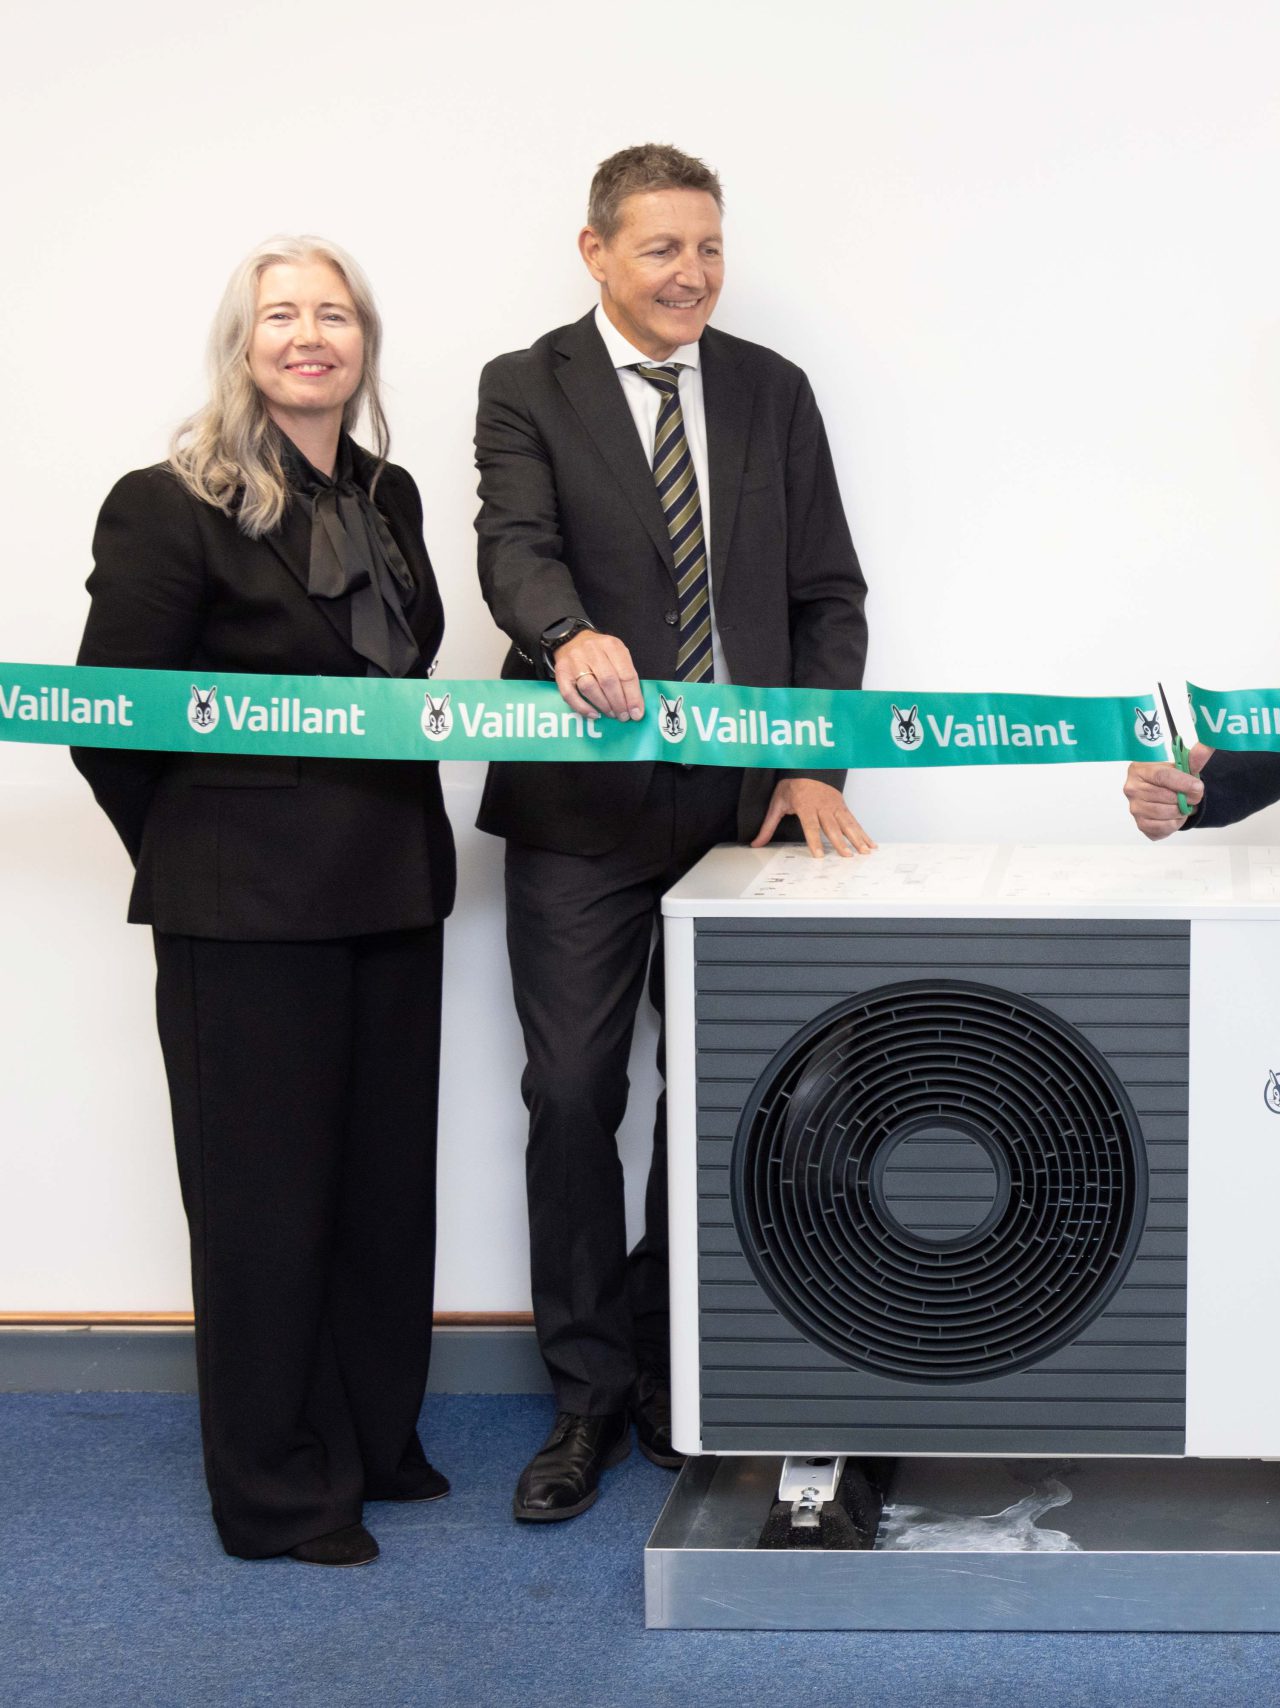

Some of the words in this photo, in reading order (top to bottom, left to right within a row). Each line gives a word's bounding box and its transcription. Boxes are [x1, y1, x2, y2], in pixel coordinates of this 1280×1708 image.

[0, 684, 133, 726] Vaillant
[225, 695, 365, 735] Vaillant
[458, 702, 602, 738] Vaillant
[692, 706, 835, 747] Vaillant
[927, 713, 1077, 748] Vaillant
